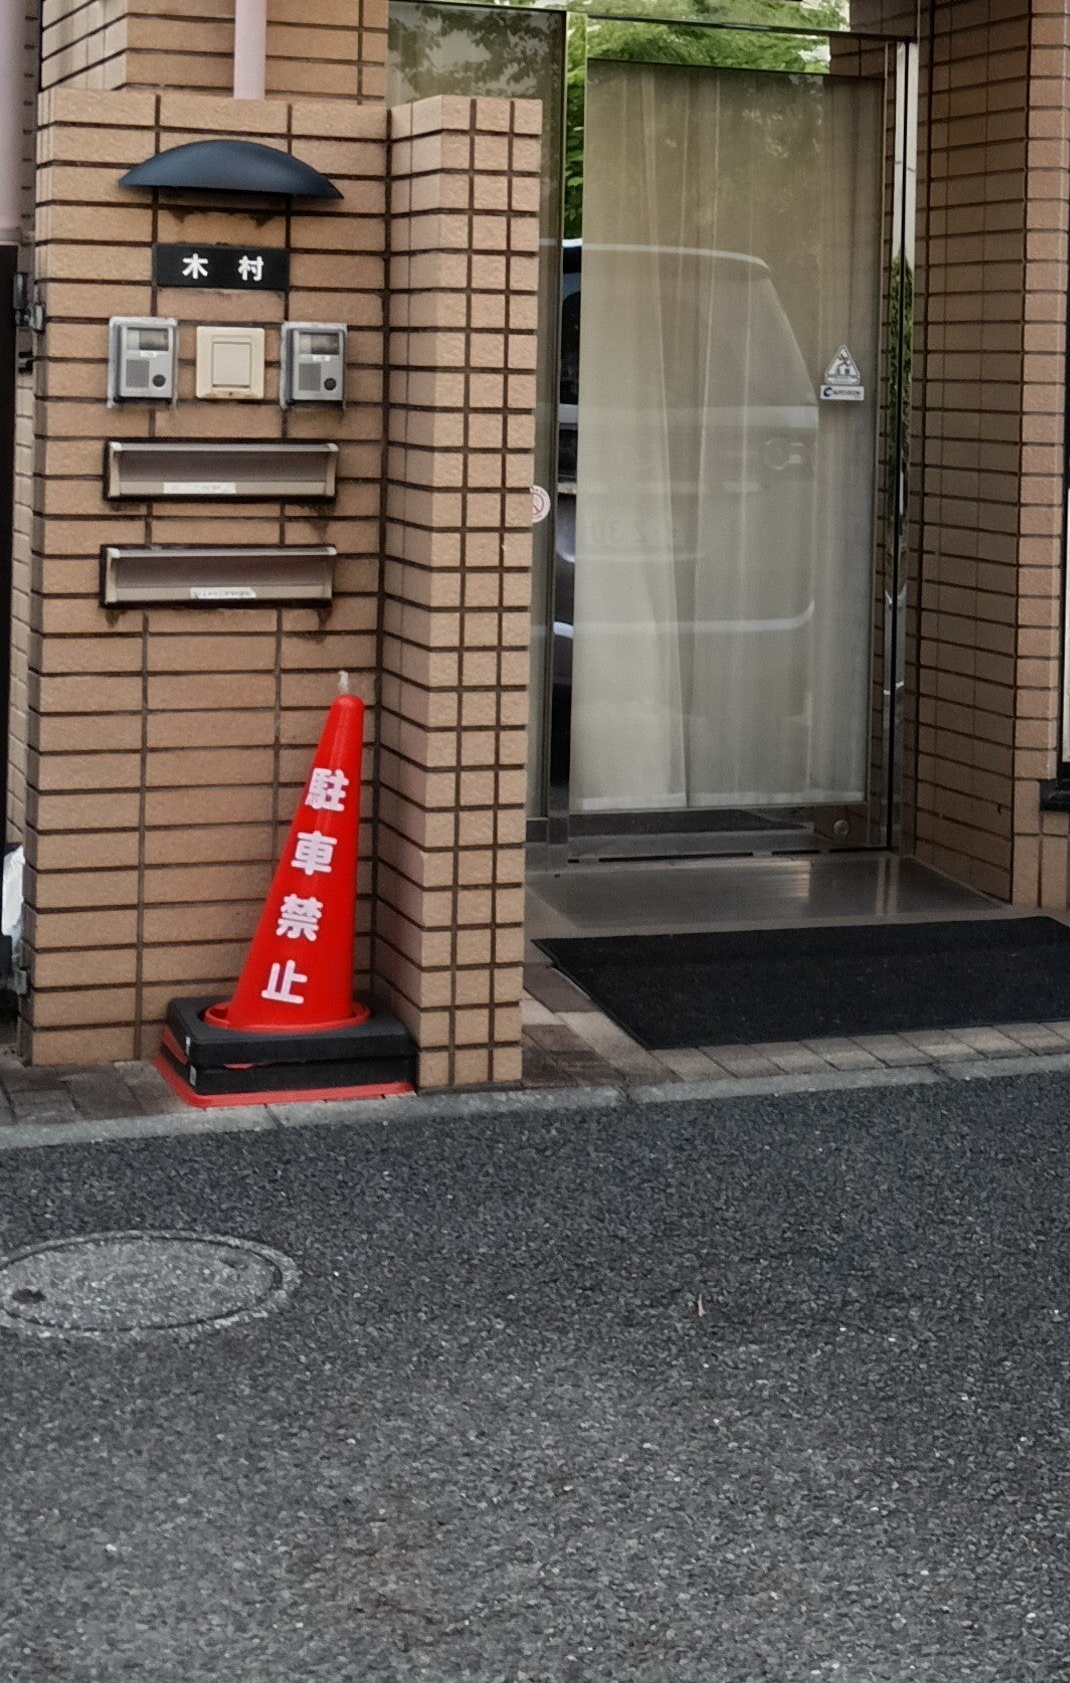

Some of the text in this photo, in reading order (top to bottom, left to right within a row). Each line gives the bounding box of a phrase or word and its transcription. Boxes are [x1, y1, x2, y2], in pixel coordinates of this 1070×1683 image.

[181, 252, 265, 282] 木村
[261, 767, 350, 1005] 駐車禁止
